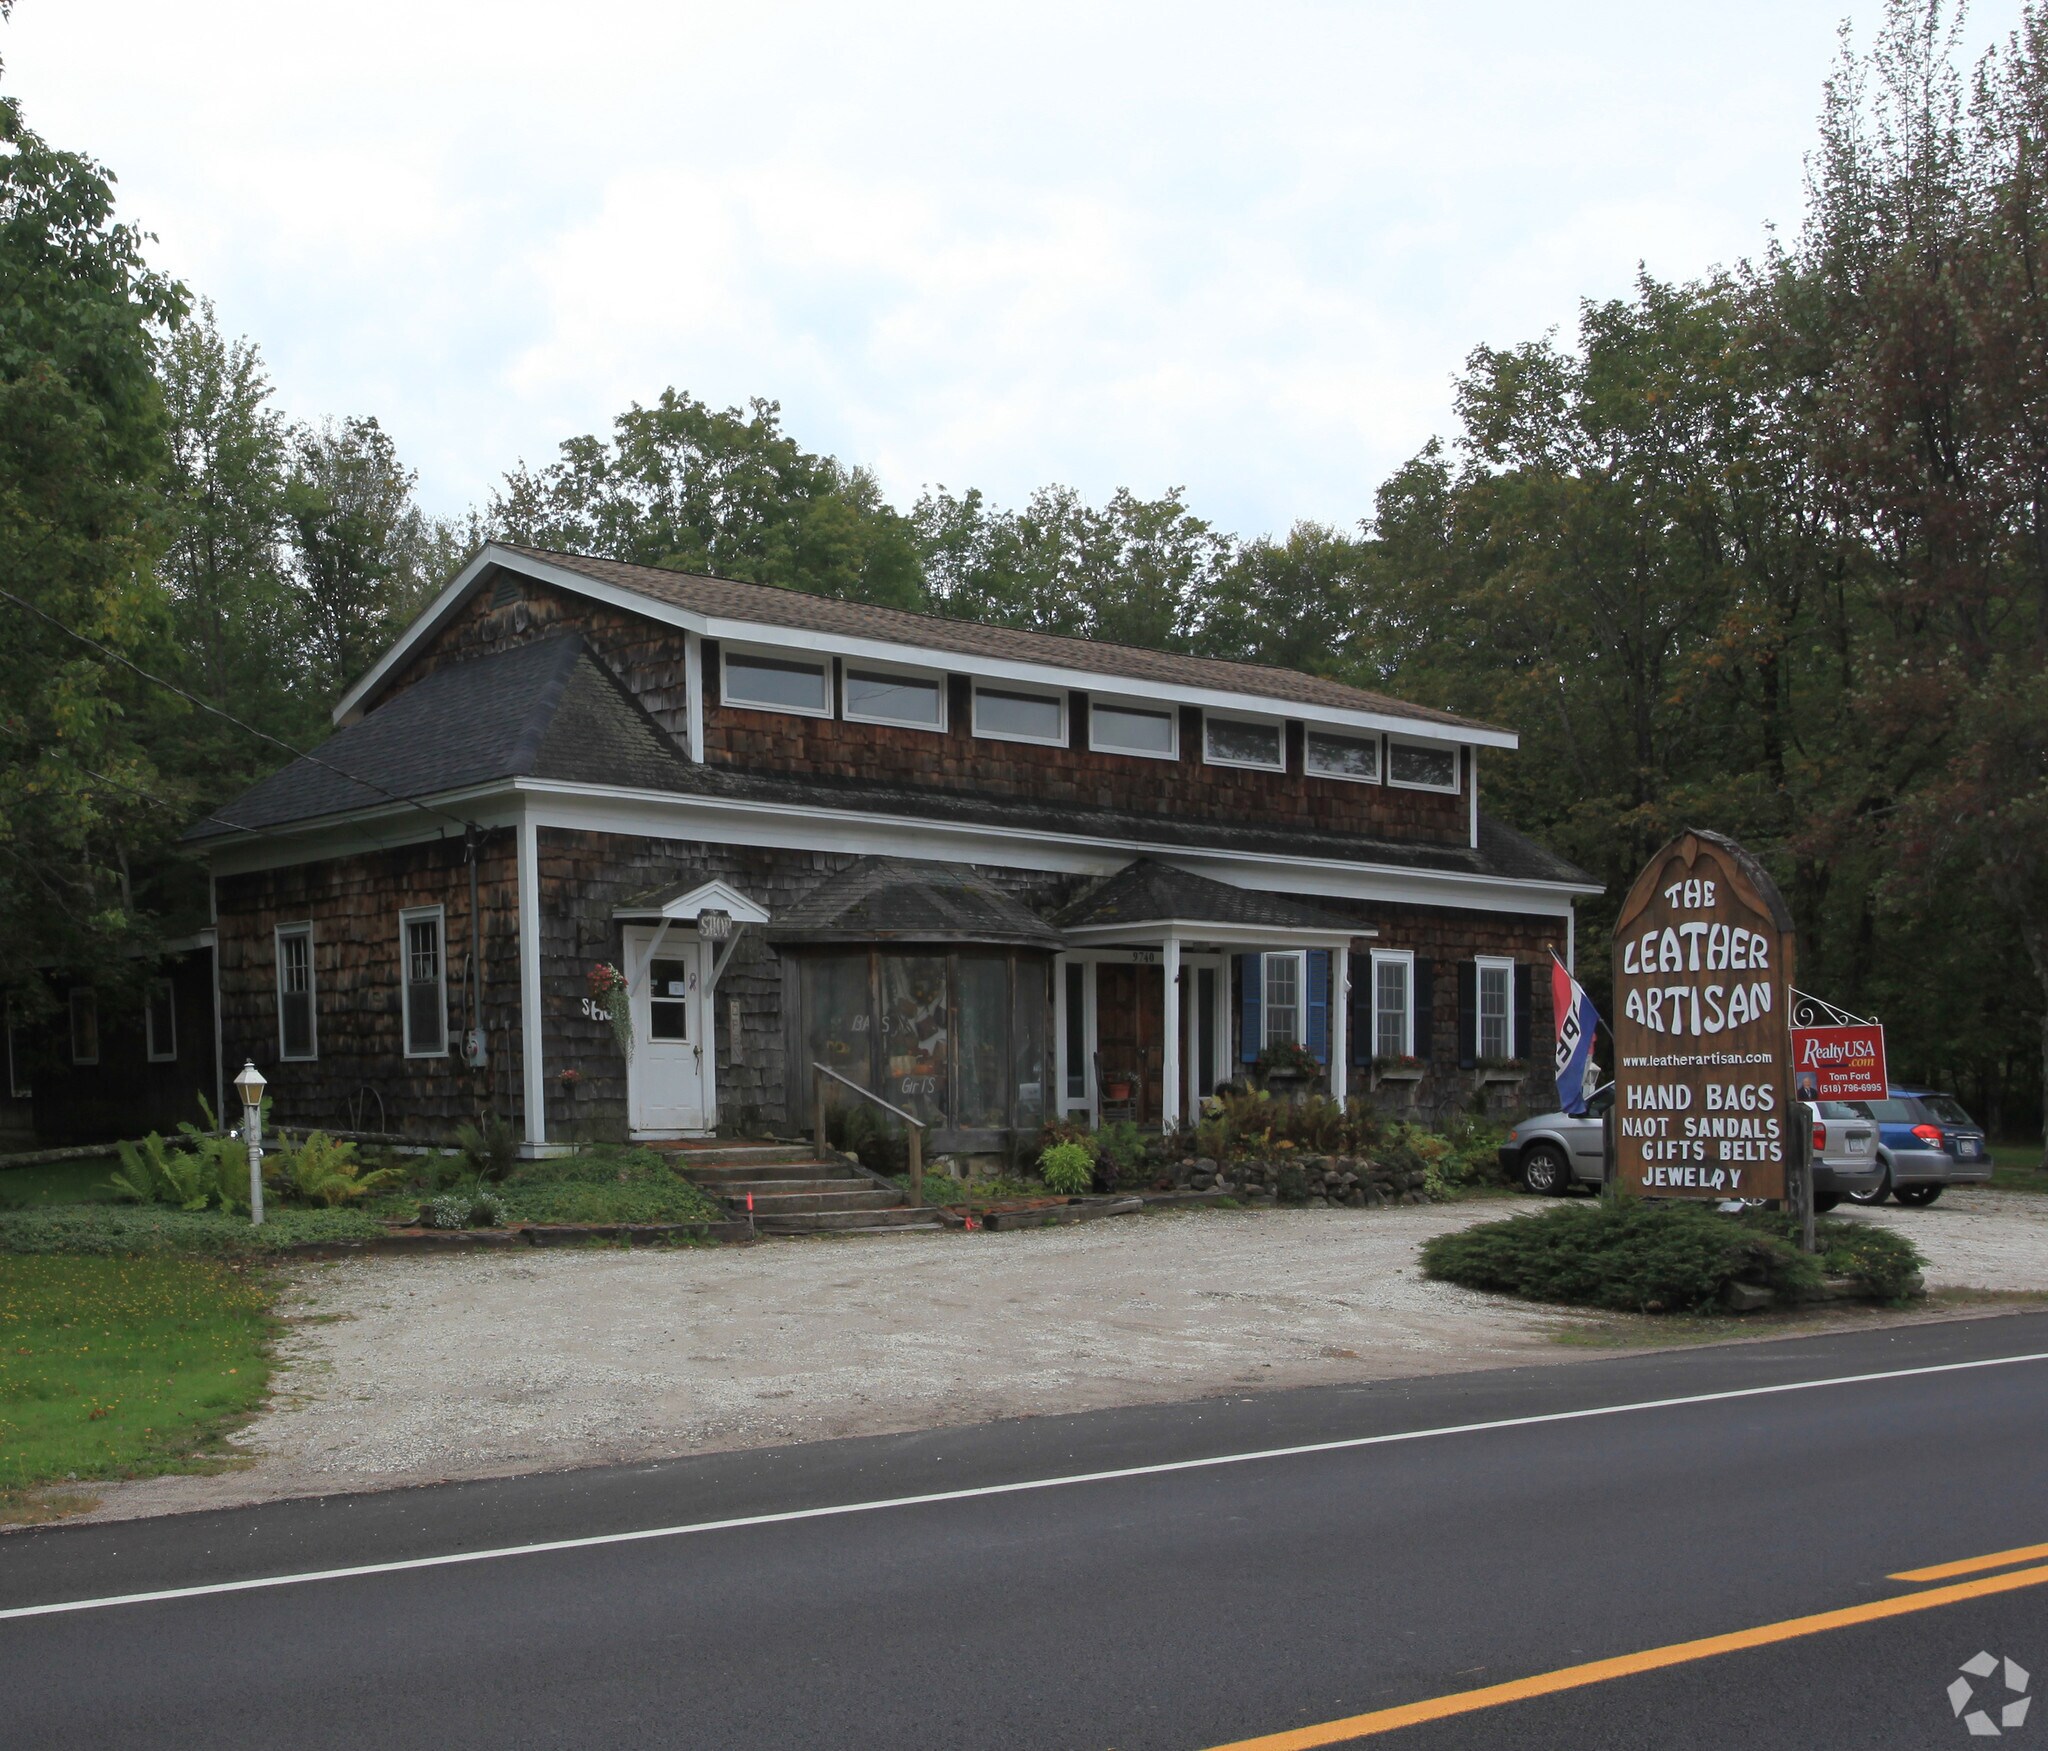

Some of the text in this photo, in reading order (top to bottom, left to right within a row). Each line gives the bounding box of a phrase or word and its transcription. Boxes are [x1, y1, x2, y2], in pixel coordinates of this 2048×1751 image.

[1664, 879, 1716, 908] THE
[699, 915, 732, 938] SHOP
[1132, 951, 1155, 963] 9740
[1623, 922, 1769, 974] LEATHER
[1625, 982, 1771, 1036] ARTISAN
[851, 1014, 890, 1032] BAS
[1623, 1053, 1772, 1067] www.leatherartisan.com
[1801, 1038, 1875, 1068] RealtyUSA
[1848, 1057, 1874, 1067] .com
[1829, 1072, 1871, 1081] Tom Ford
[1627, 1084, 1774, 1111] HAND BAGS
[1820, 1083, 1882, 1094] (518) 796-6995
[1622, 1117, 1780, 1139] NAOT SANDALS
[1641, 1141, 1782, 1162] GIFTS BELTS
[1642, 1167, 1742, 1190] JEWELRY
